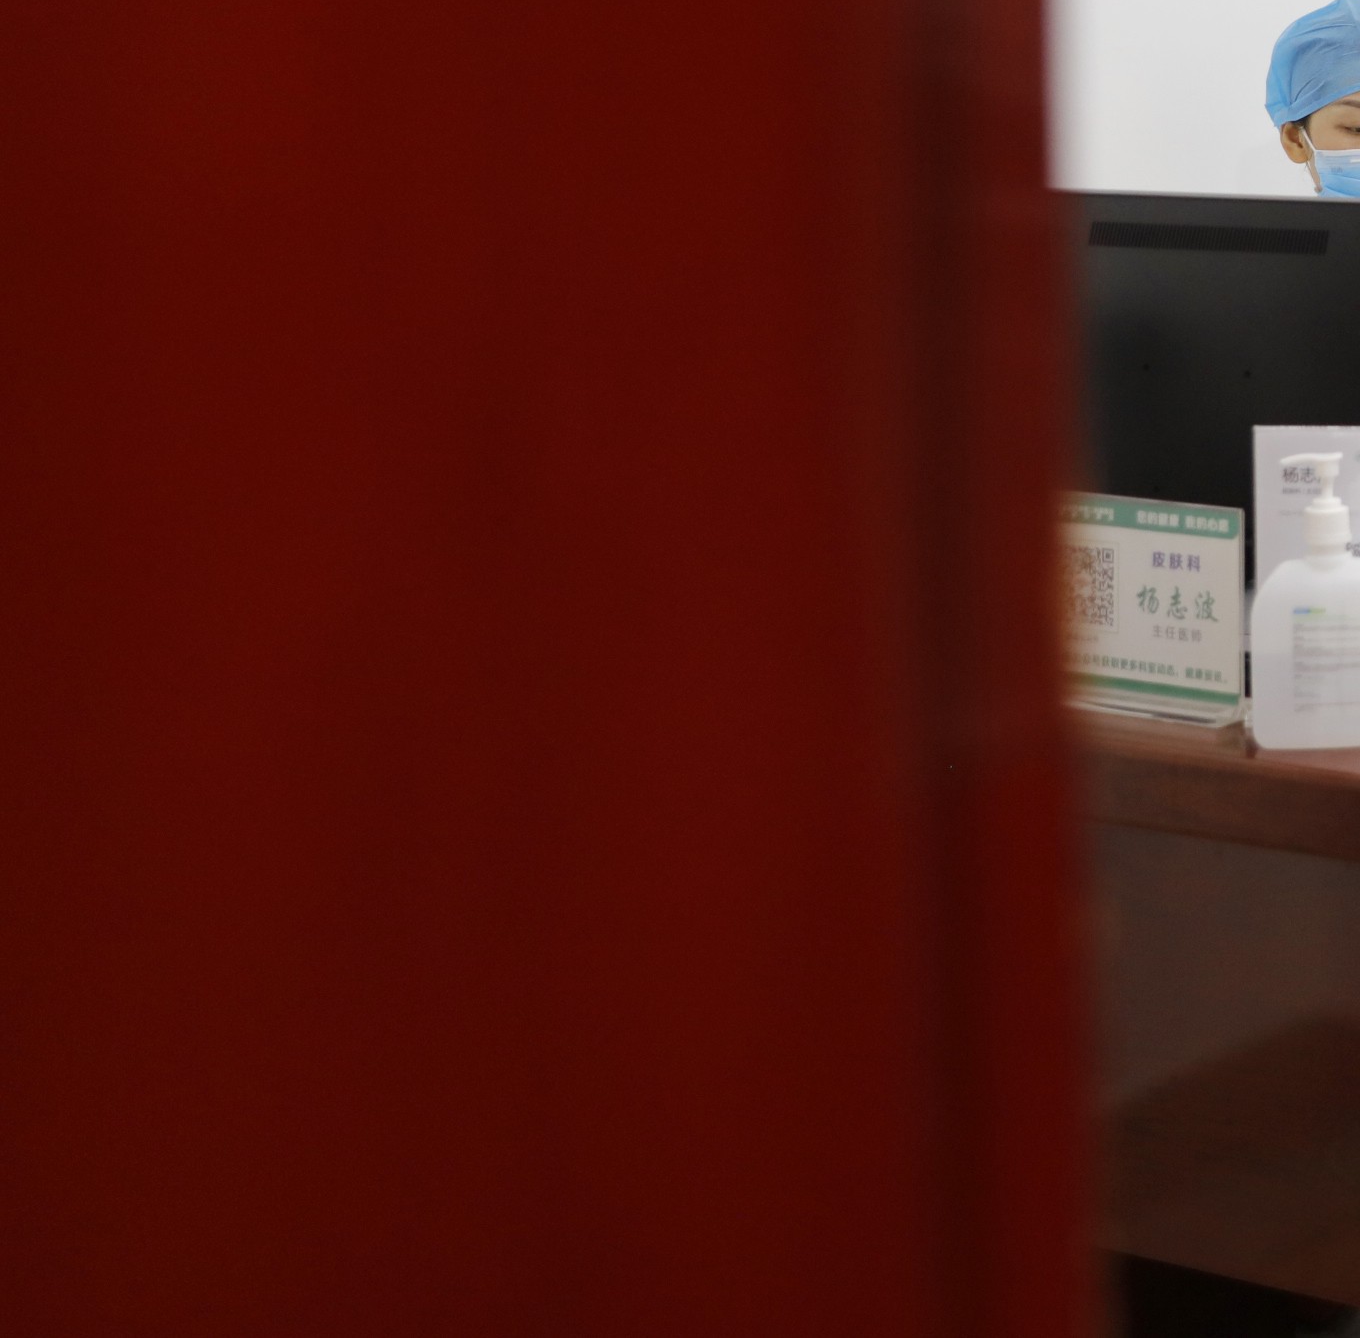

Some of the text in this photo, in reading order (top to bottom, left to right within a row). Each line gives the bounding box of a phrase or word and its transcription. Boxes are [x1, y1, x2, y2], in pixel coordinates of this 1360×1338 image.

[1282, 467, 1322, 484] 杨志
[1152, 551, 1201, 573] 皮肤科
[1136, 585, 1219, 623] 杨志波
[1152, 625, 1203, 643] 主任医师
